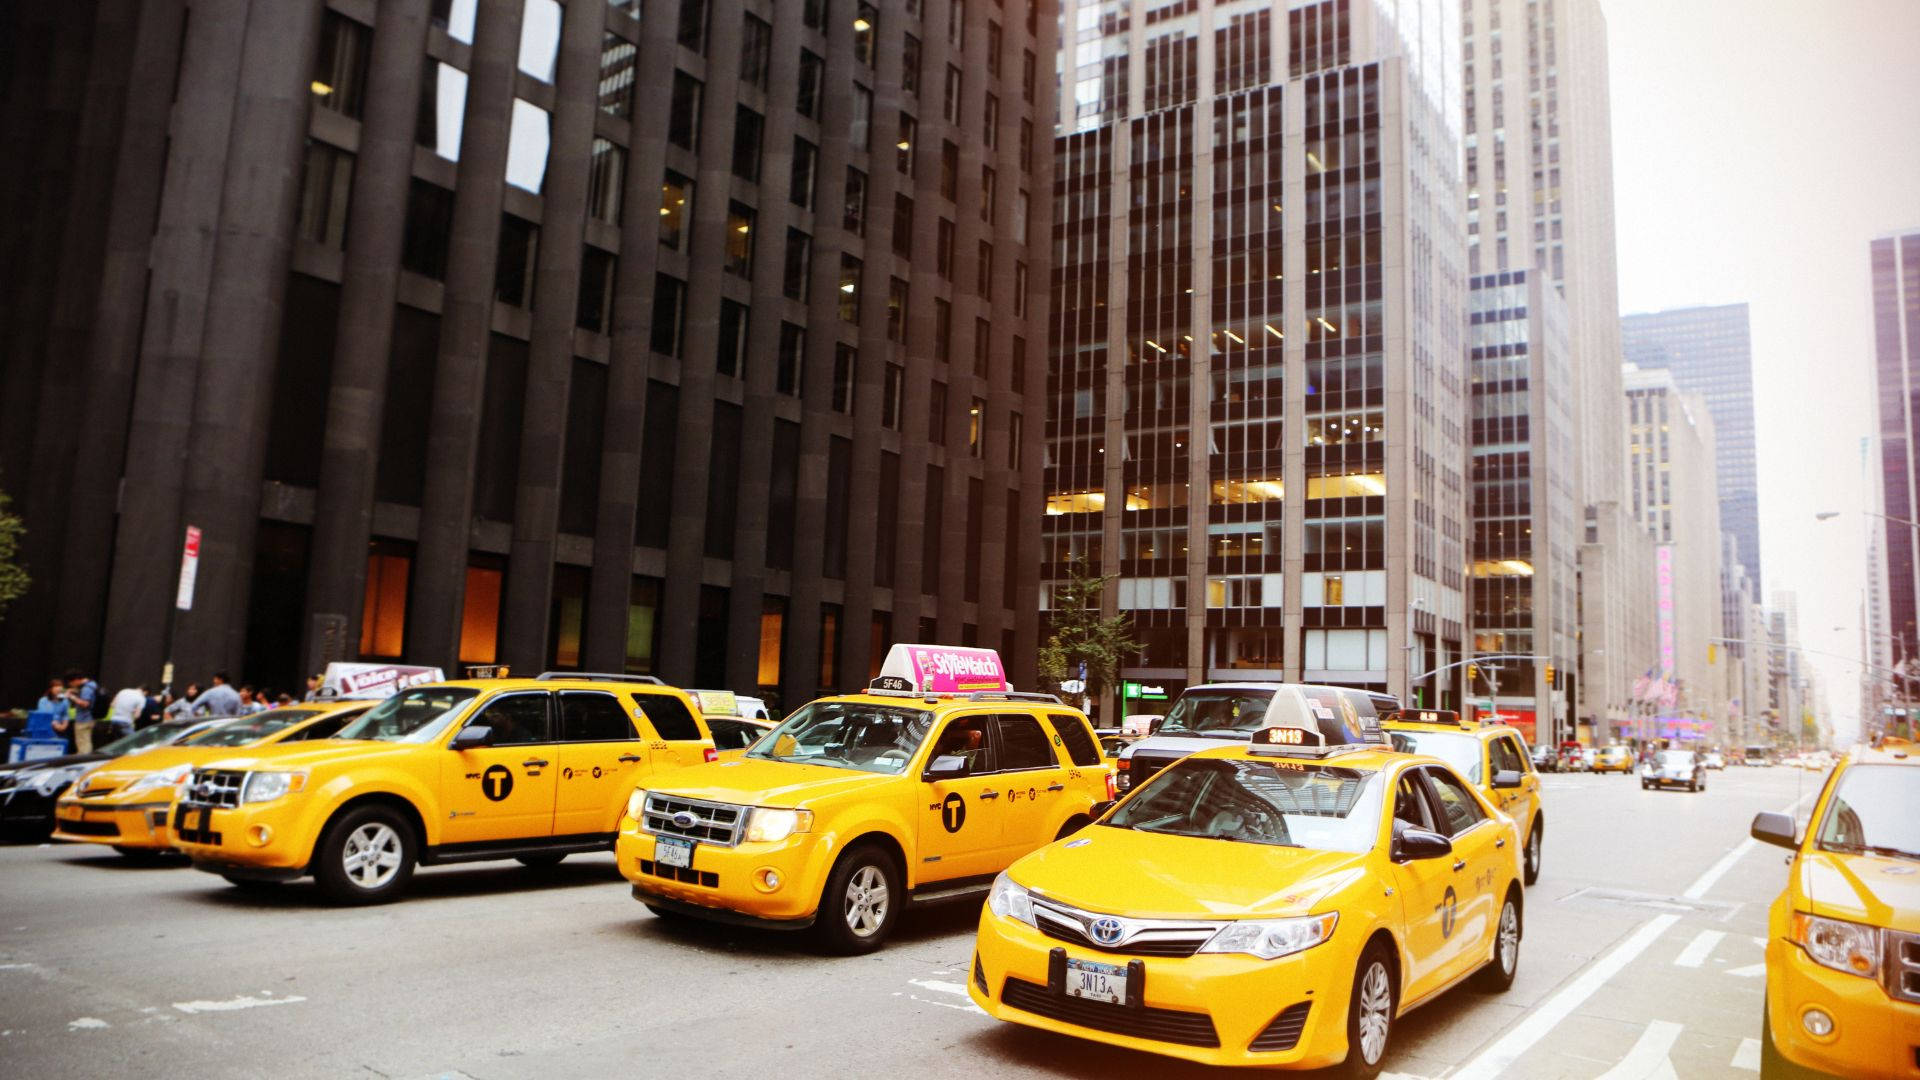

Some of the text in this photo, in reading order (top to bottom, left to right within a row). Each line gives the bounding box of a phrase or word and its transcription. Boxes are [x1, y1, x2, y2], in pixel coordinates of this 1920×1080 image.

[932, 652, 999, 680] StyleWatch
[883, 678, 902, 689] 5F46
[1269, 728, 1303, 744] 3N13
[488, 771, 507, 797] T
[929, 800, 961, 828] NYC T
[1080, 972, 1114, 995] 3N13A
